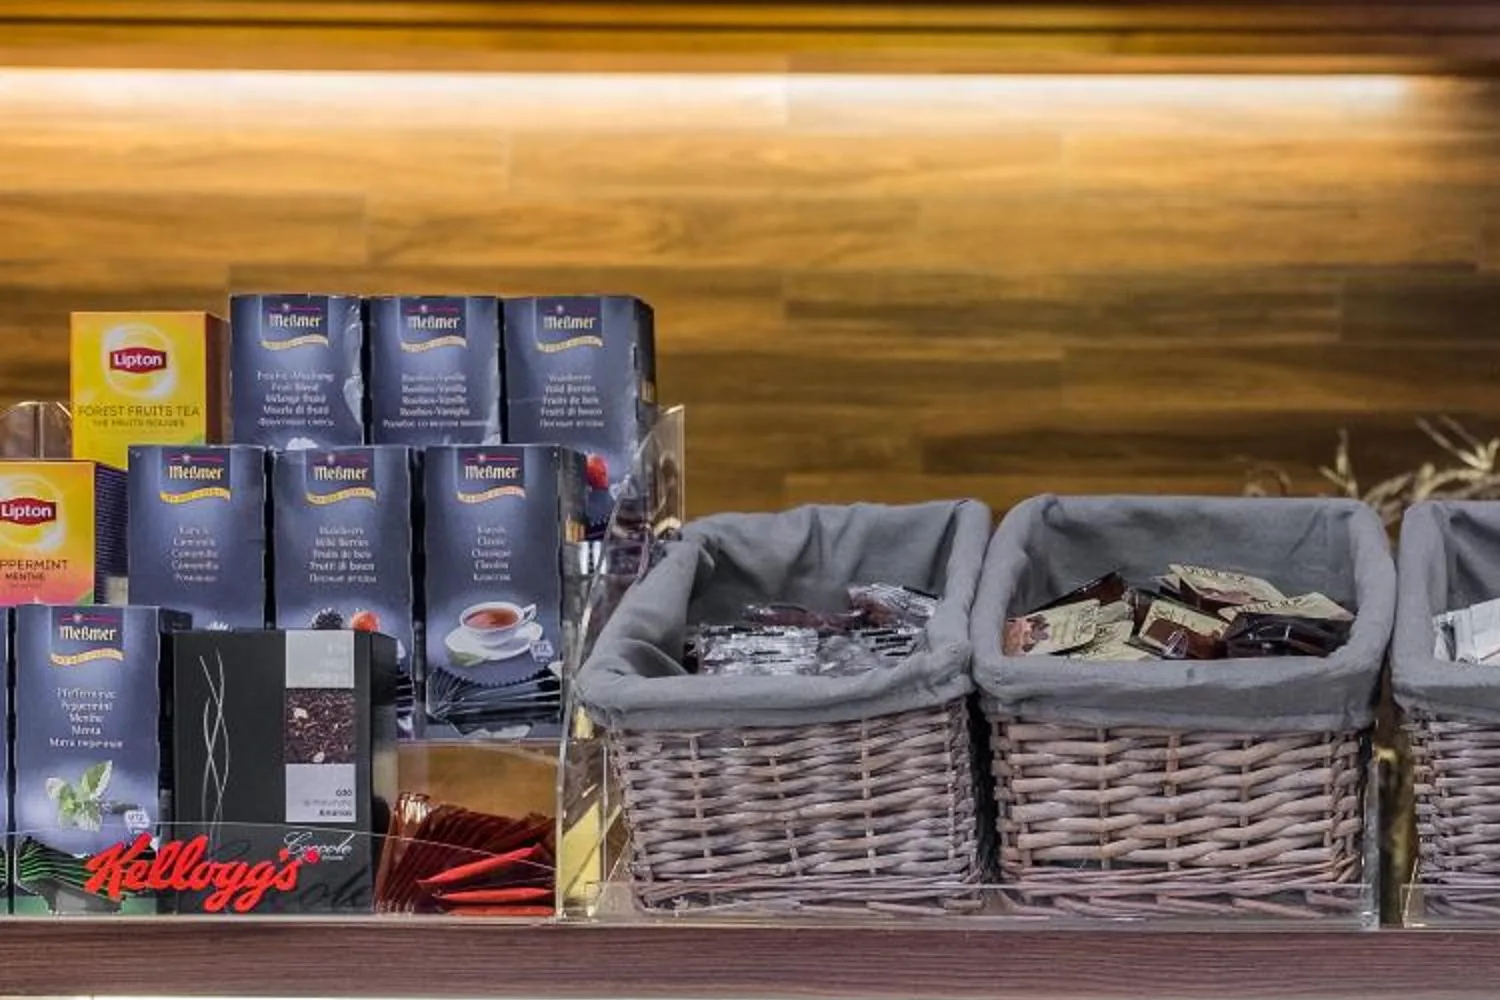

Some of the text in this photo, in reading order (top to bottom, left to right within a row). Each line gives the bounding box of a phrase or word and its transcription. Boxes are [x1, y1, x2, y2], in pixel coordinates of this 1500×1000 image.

[113, 353, 163, 369] Lipton
[77, 404, 201, 417] FOREST FRUITS TEA
[168, 465, 224, 480] Meßmer
[313, 466, 368, 481] Meßmer
[464, 465, 519, 480] Meßmer
[1, 503, 52, 520] Lipton
[60, 626, 117, 641] Meßmer
[84, 832, 304, 912] Kellogg's
